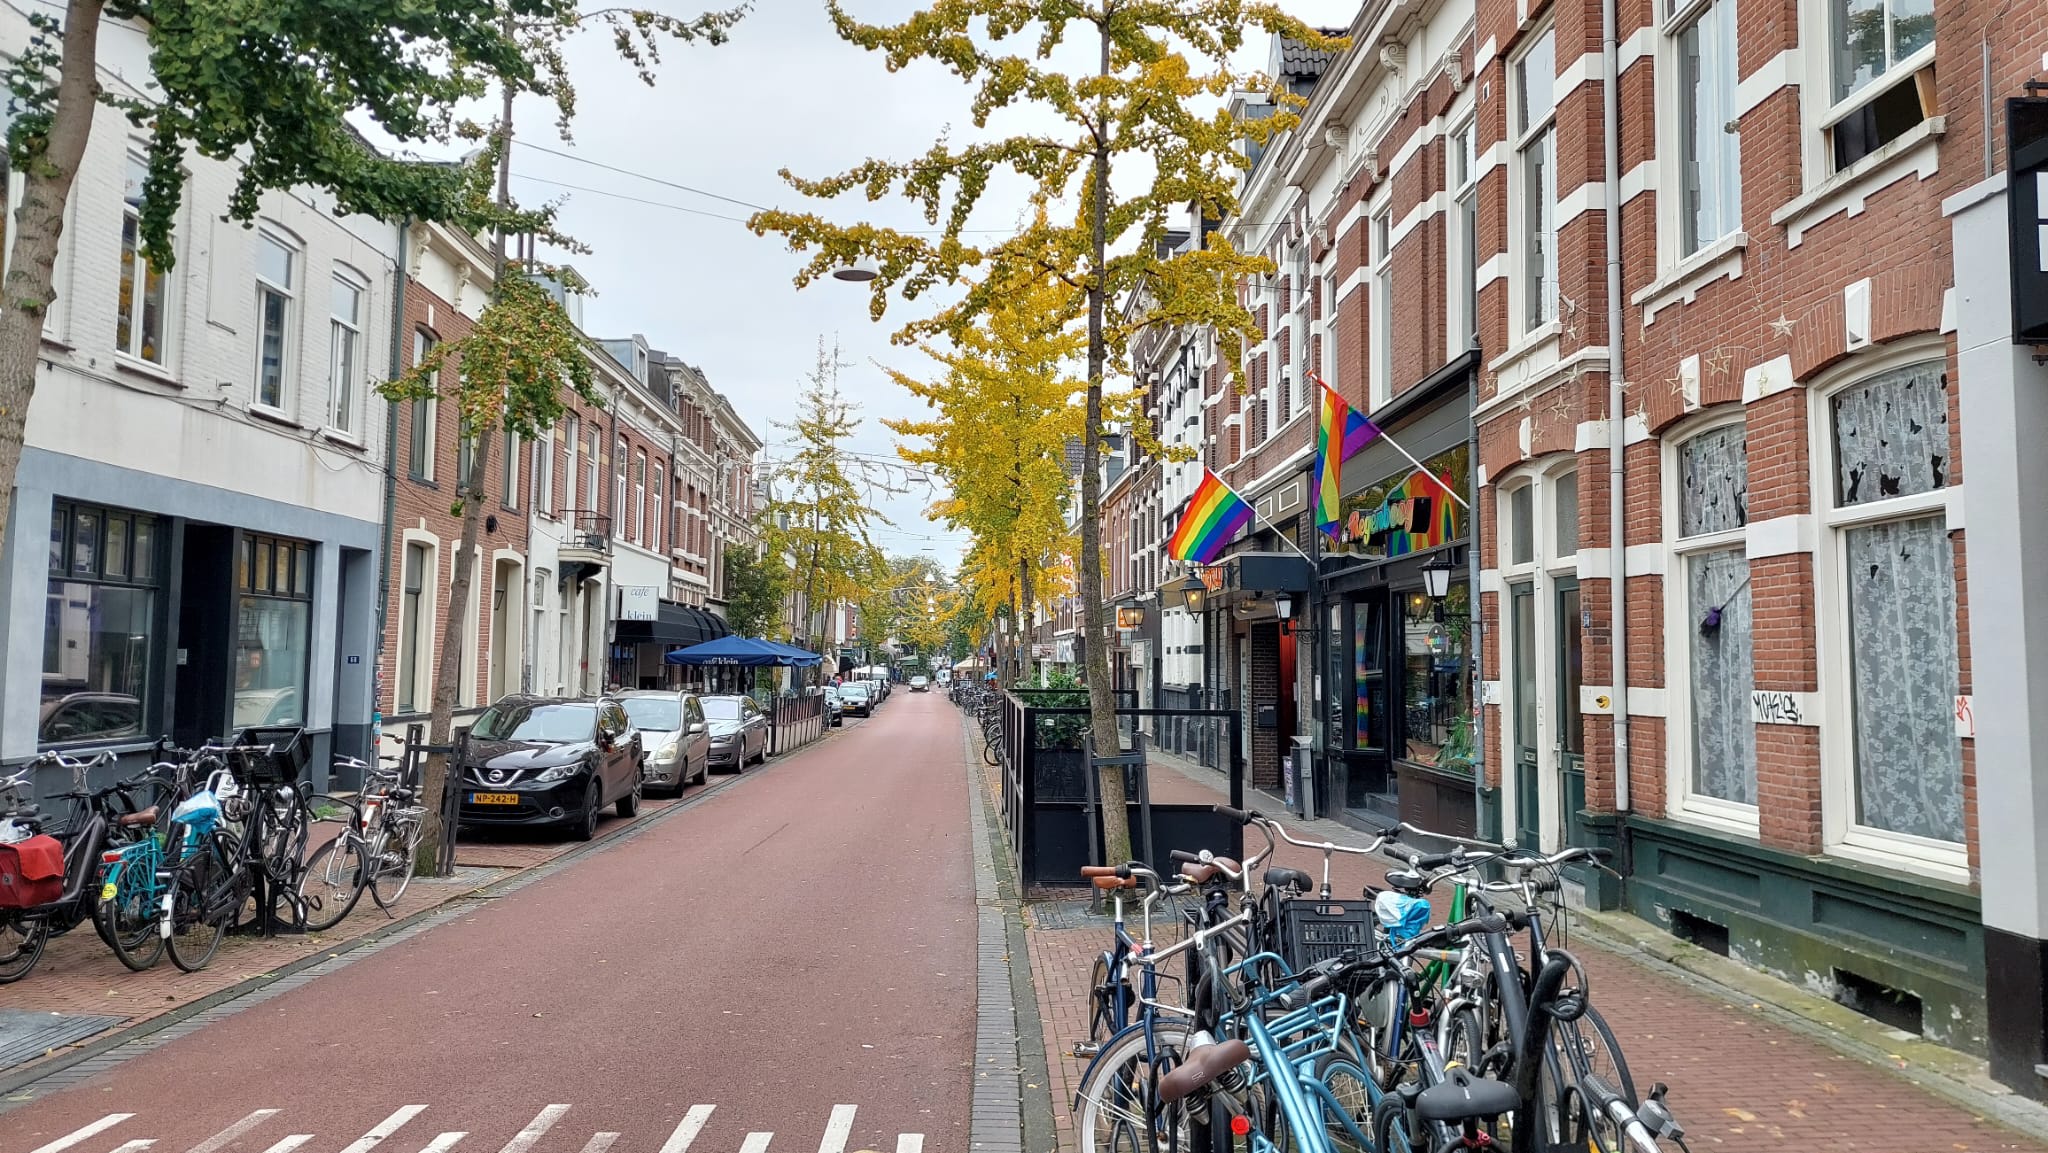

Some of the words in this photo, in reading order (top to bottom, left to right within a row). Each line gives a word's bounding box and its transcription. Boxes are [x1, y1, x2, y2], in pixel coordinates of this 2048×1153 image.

[627, 610, 652, 620] klein
[718, 657, 739, 665] klein
[476, 794, 516, 803] NP-242-H
